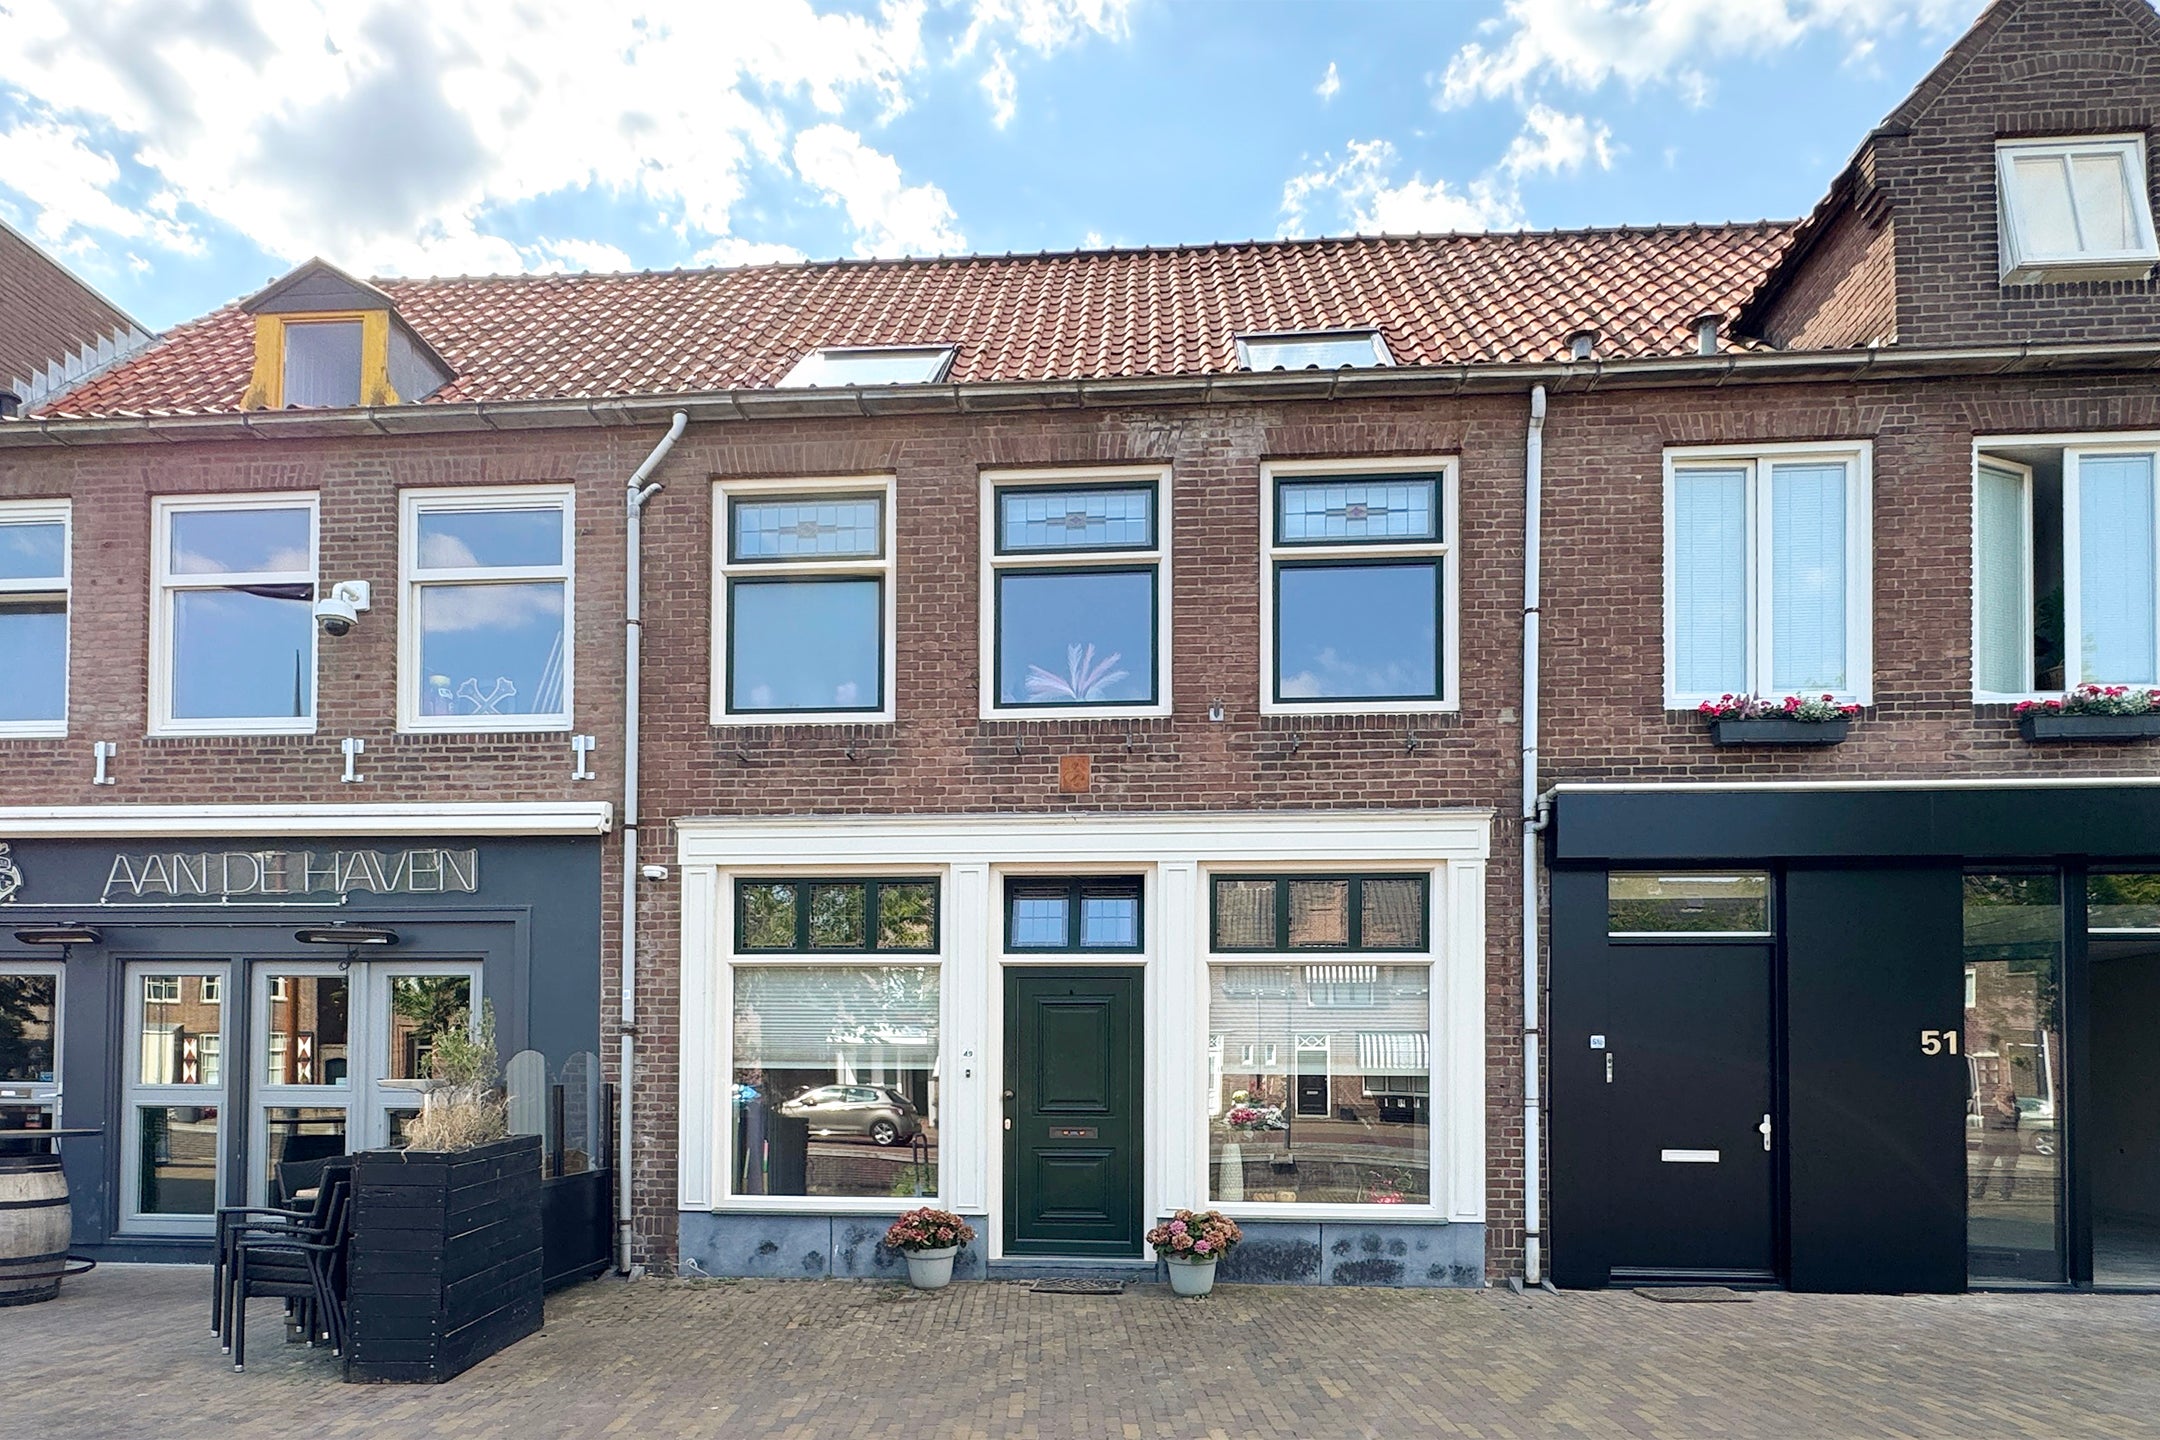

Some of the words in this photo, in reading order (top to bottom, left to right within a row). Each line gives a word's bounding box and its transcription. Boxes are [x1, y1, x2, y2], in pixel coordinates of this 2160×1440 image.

[102, 853, 207, 896] AAN
[223, 851, 289, 894] DE
[304, 850, 477, 893] HAVEN
[1921, 1030, 1958, 1055] 51
